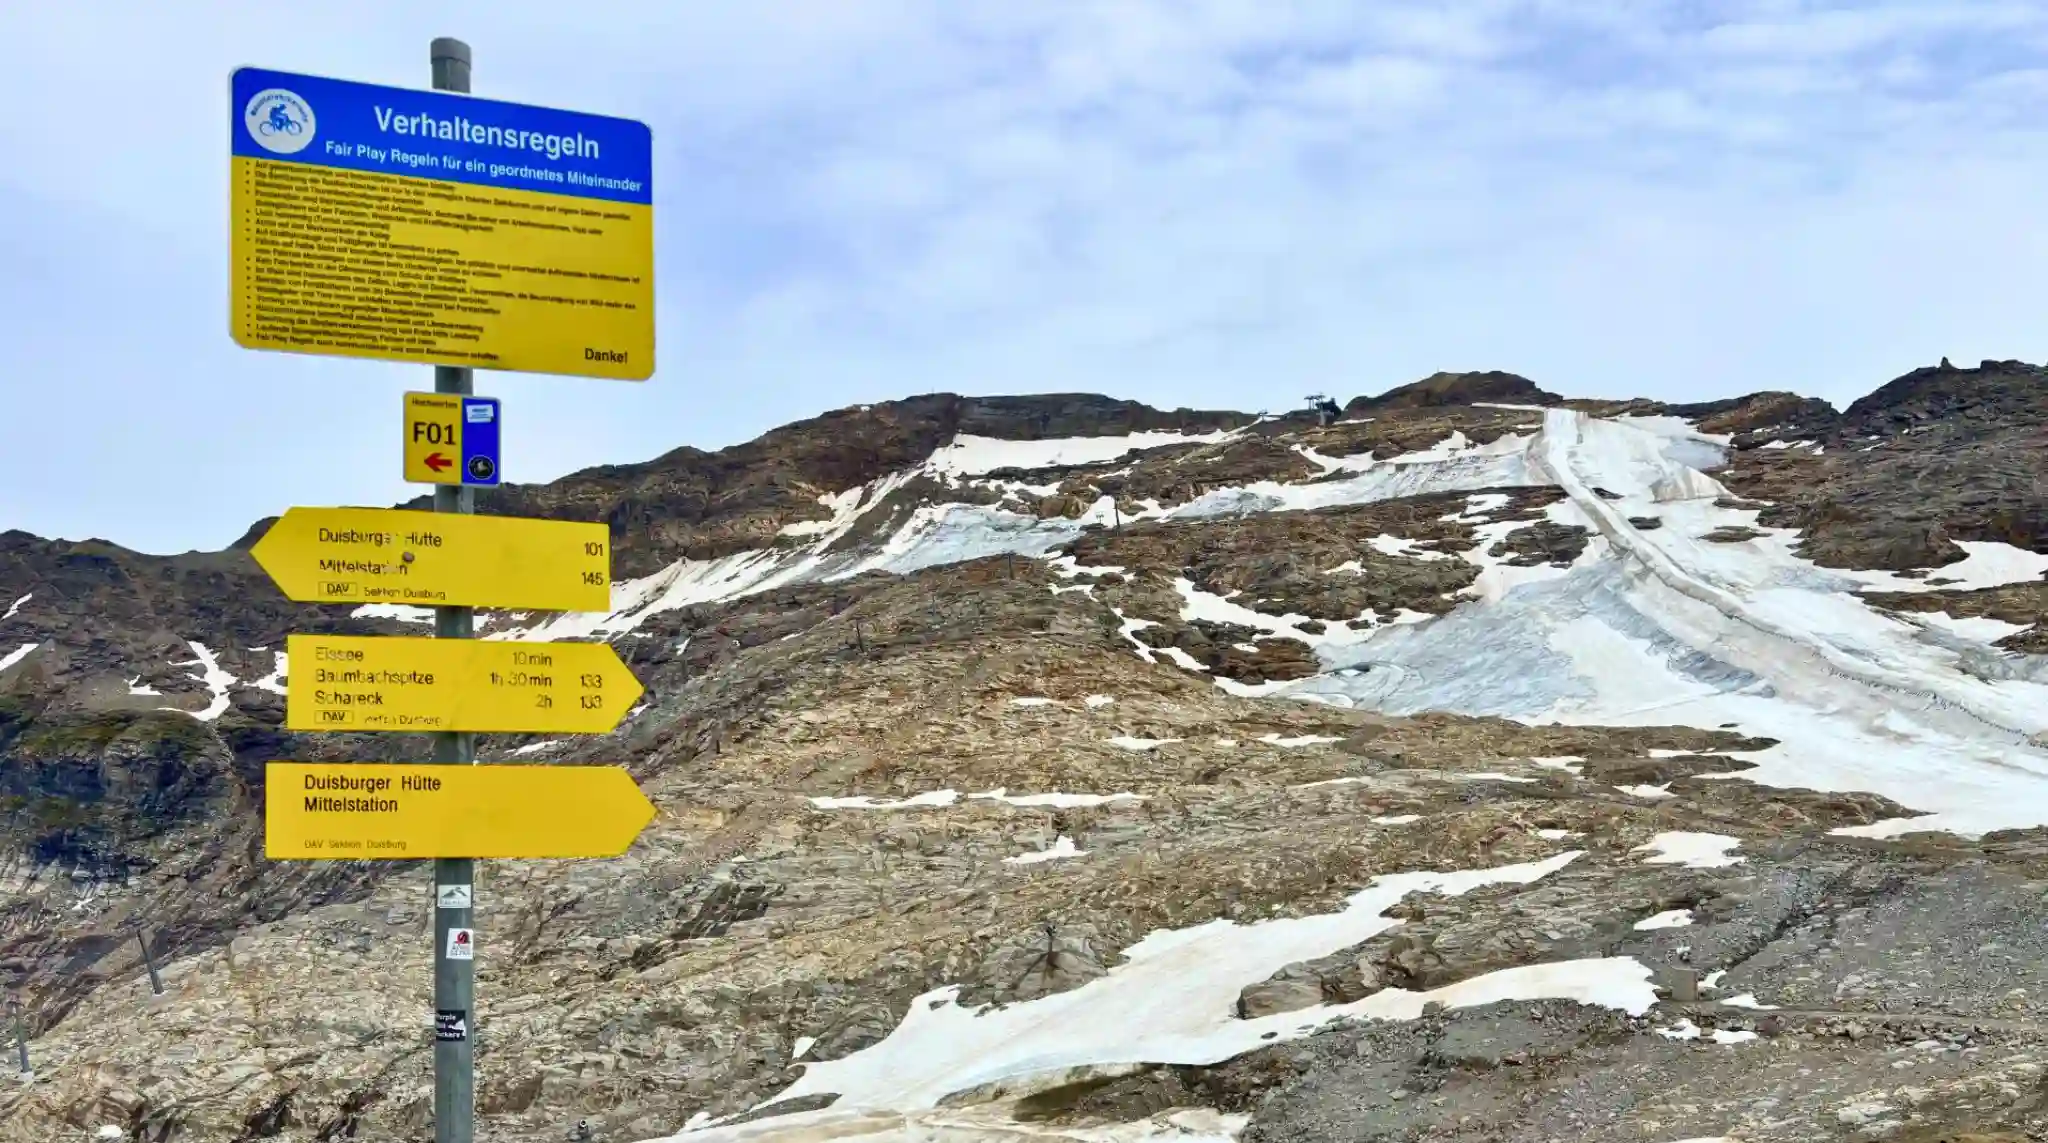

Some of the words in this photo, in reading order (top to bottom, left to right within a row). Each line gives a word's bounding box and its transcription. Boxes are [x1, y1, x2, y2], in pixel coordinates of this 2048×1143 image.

[374, 105, 600, 160] Verhaltensregeln
[325, 140, 353, 157] Fair
[357, 144, 386, 163] Play
[391, 148, 439, 168] Regeln
[443, 155, 462, 171] für
[465, 159, 486, 173] ein
[490, 162, 564, 183] geordnetes
[567, 170, 642, 193] Miteinander
[584, 347, 628, 365] Danke!
[413, 421, 457, 446] F01
[319, 527, 399, 547] Duisburge
[584, 542, 604, 557] 101
[319, 558, 409, 575] Mittelstan
[581, 571, 604, 586] 145
[326, 582, 350, 596] DAV
[513, 651, 527, 666] 10
[529, 653, 552, 667] min
[490, 671, 504, 686] 1h
[529, 673, 552, 688] min
[535, 693, 552, 709] 2h
[304, 774, 392, 794] Duisburger
[401, 774, 442, 791] Hütte
[304, 796, 398, 812] Mittelstation
[304, 838, 324, 850] DAV
